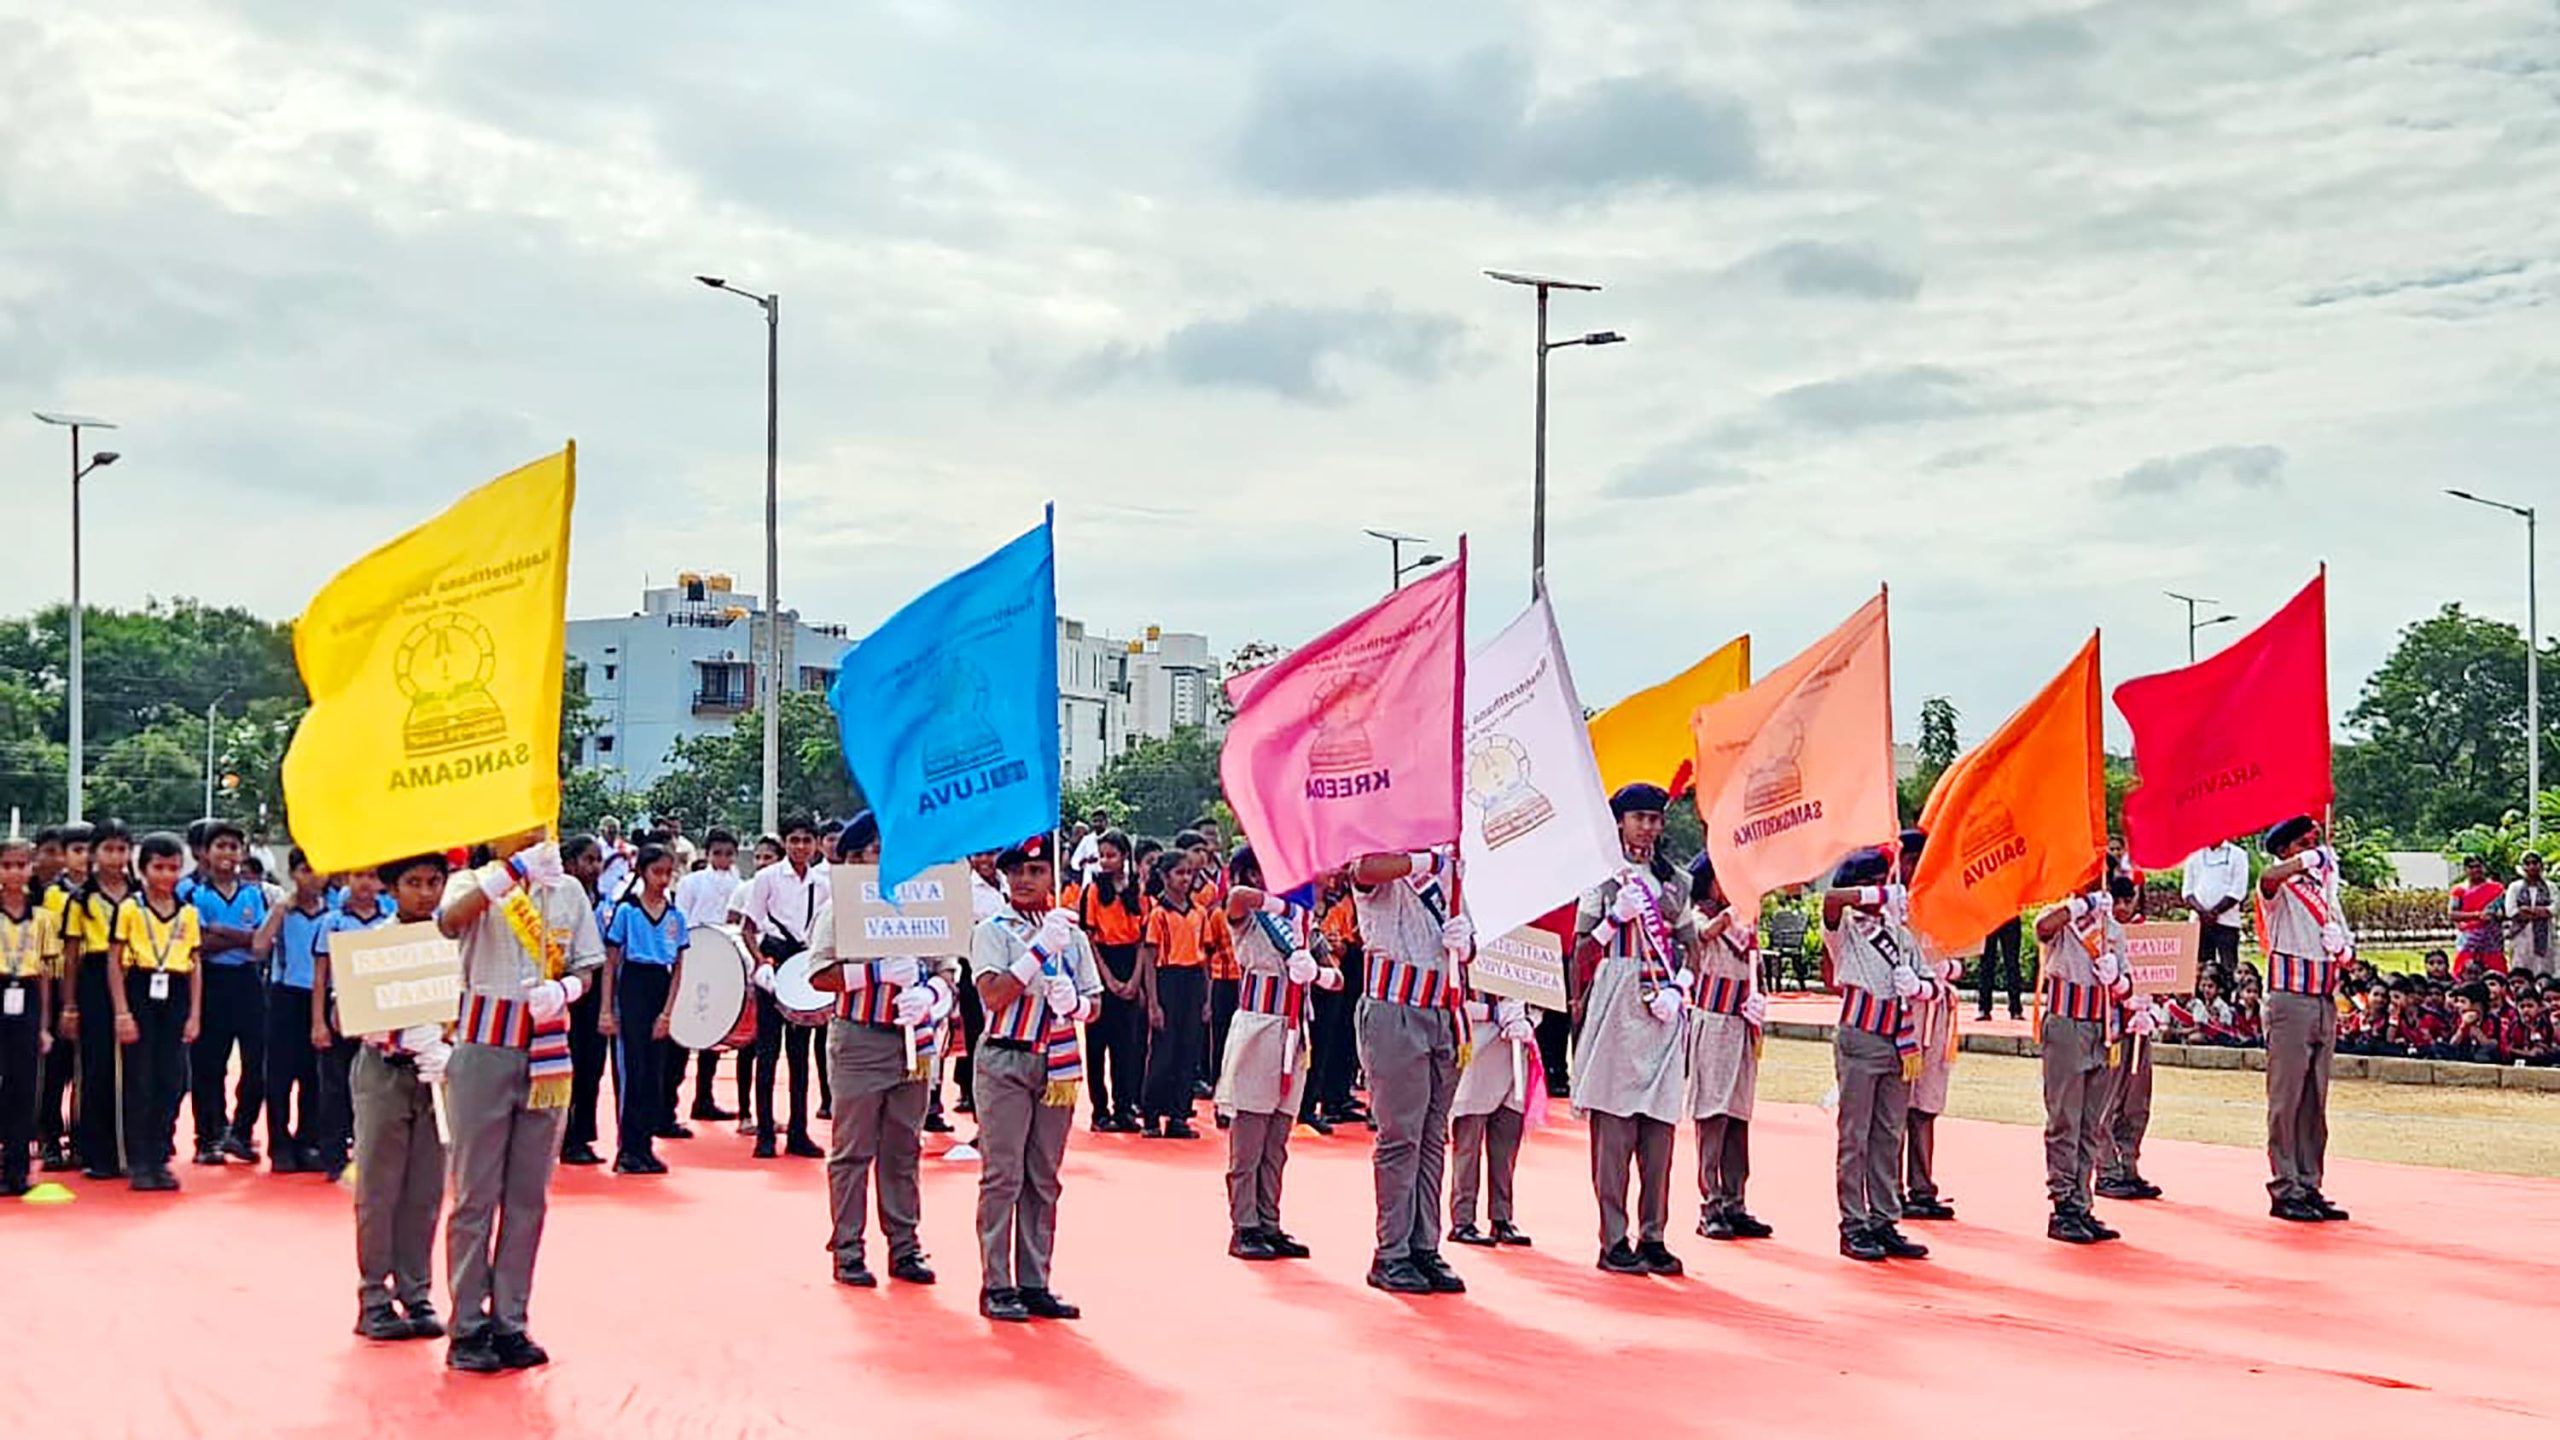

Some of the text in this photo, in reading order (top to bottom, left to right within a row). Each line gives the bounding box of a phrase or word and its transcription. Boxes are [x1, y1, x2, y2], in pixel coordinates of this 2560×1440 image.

[865, 884, 941, 900] SUVA
[868, 919, 945, 936] VAAHINI
[2133, 967, 2175, 981] AAHINI
